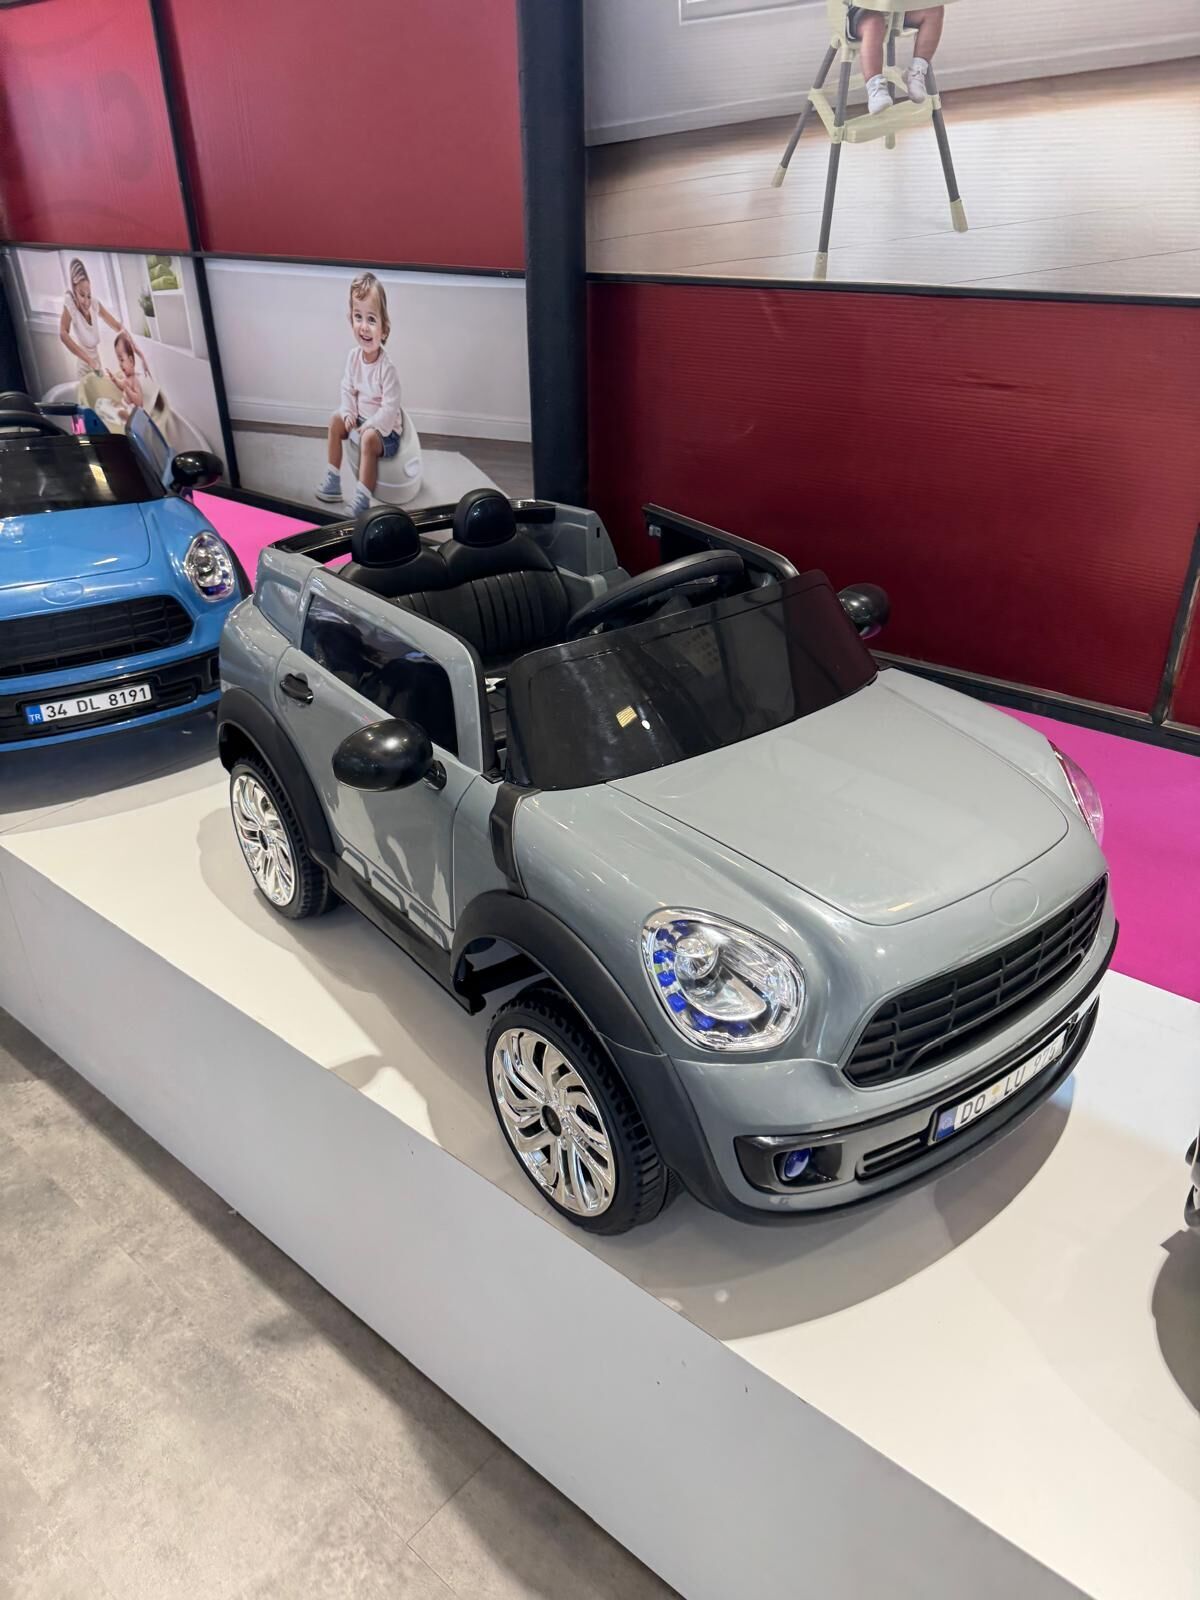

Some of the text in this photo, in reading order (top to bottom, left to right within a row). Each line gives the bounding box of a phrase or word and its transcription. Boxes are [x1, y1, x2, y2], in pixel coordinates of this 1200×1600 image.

[30, 714, 41, 722] TR
[46, 687, 147, 718] 34 DL 8191
[960, 1094, 986, 1124] DO
[1004, 1065, 1026, 1096] LU
